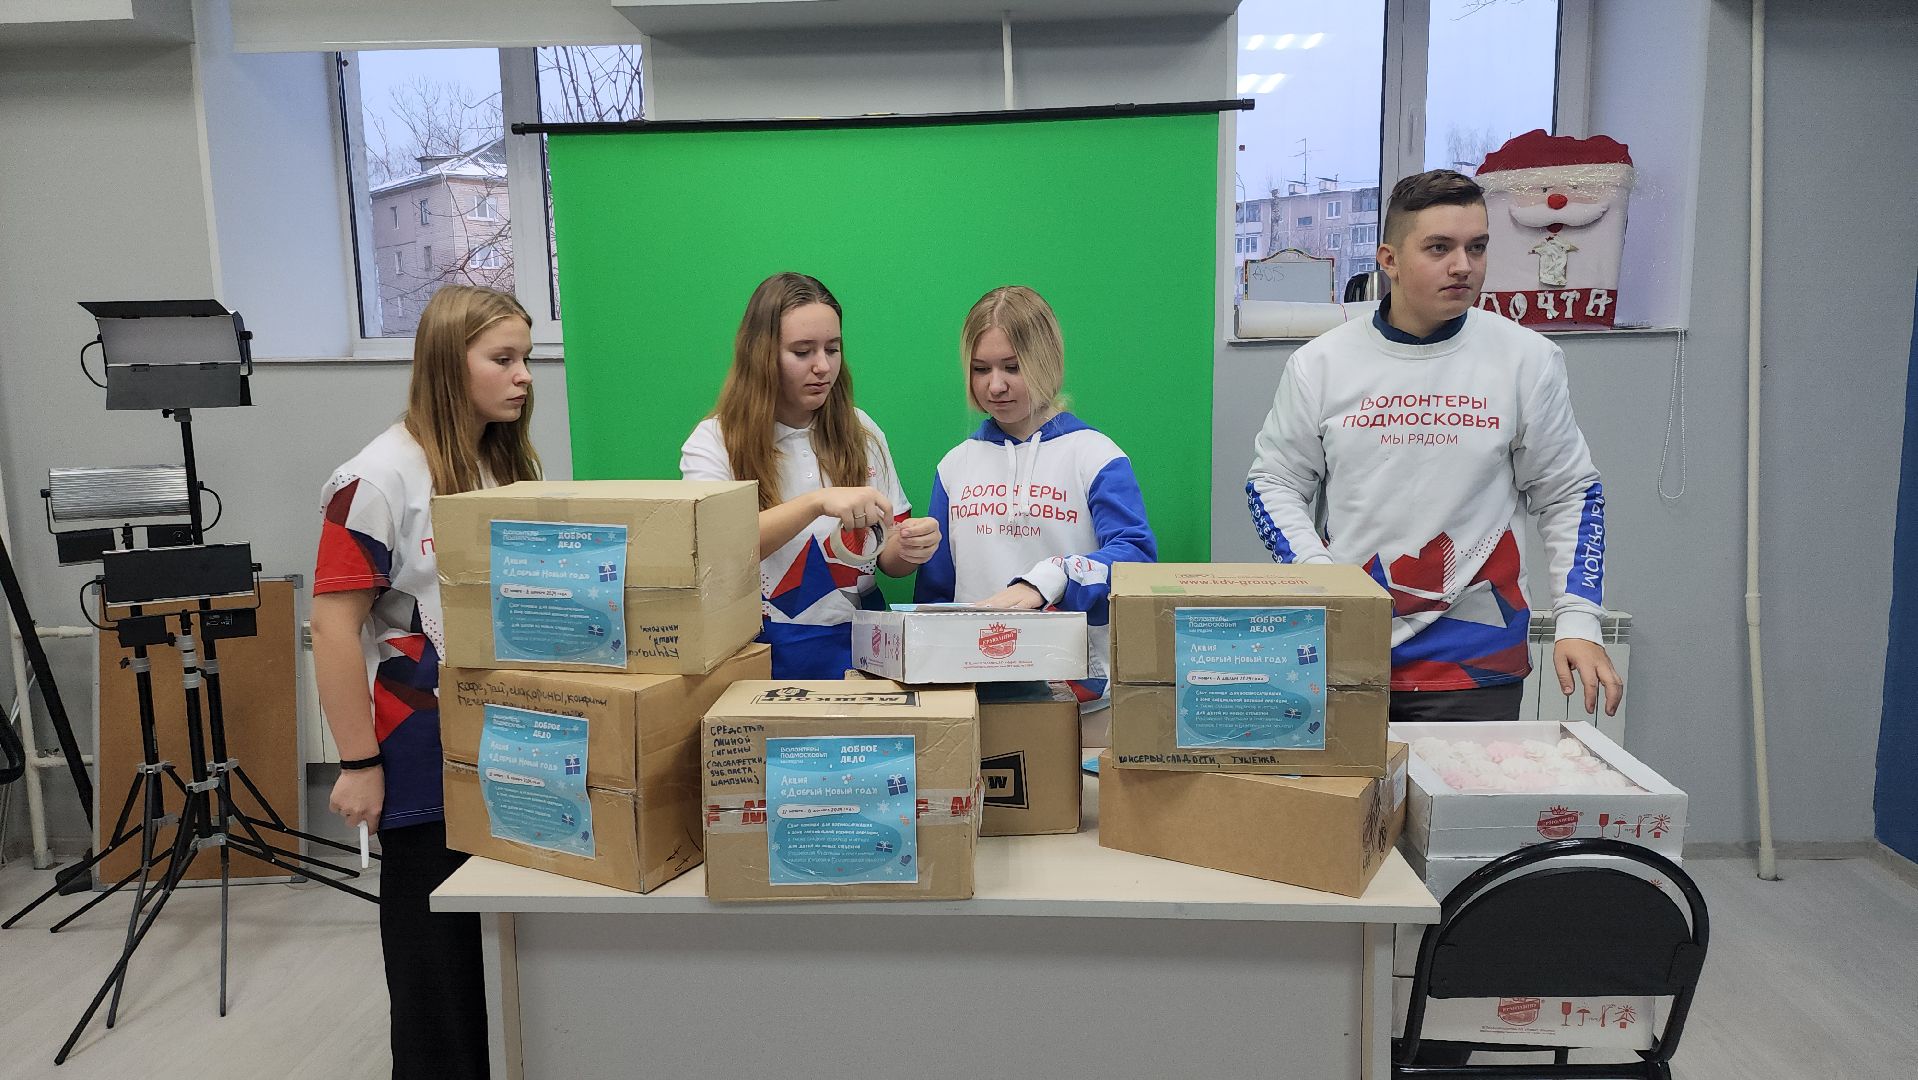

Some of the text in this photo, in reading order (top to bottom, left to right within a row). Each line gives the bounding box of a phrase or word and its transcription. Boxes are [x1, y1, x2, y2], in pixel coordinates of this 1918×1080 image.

[1478, 288, 1613, 322] ПОЧТА
[1360, 394, 1487, 411] ВОЛОНТЕРЫ
[1342, 412, 1500, 429] ПОДМОСКОВЬЯ
[1380, 433, 1458, 446] МЫ РЯДОМ
[999, 524, 1041, 538] РЯДОМ
[1581, 522, 1604, 589] РЯДОМ
[1178, 578, 1310, 587] www.kdv-group.com
[1249, 615, 1287, 624] ДОБРОЕ
[1249, 625, 1275, 633] ДЕЛО
[841, 744, 878, 754] ДОБРОЕ
[840, 755, 866, 764] ДЕЛО
